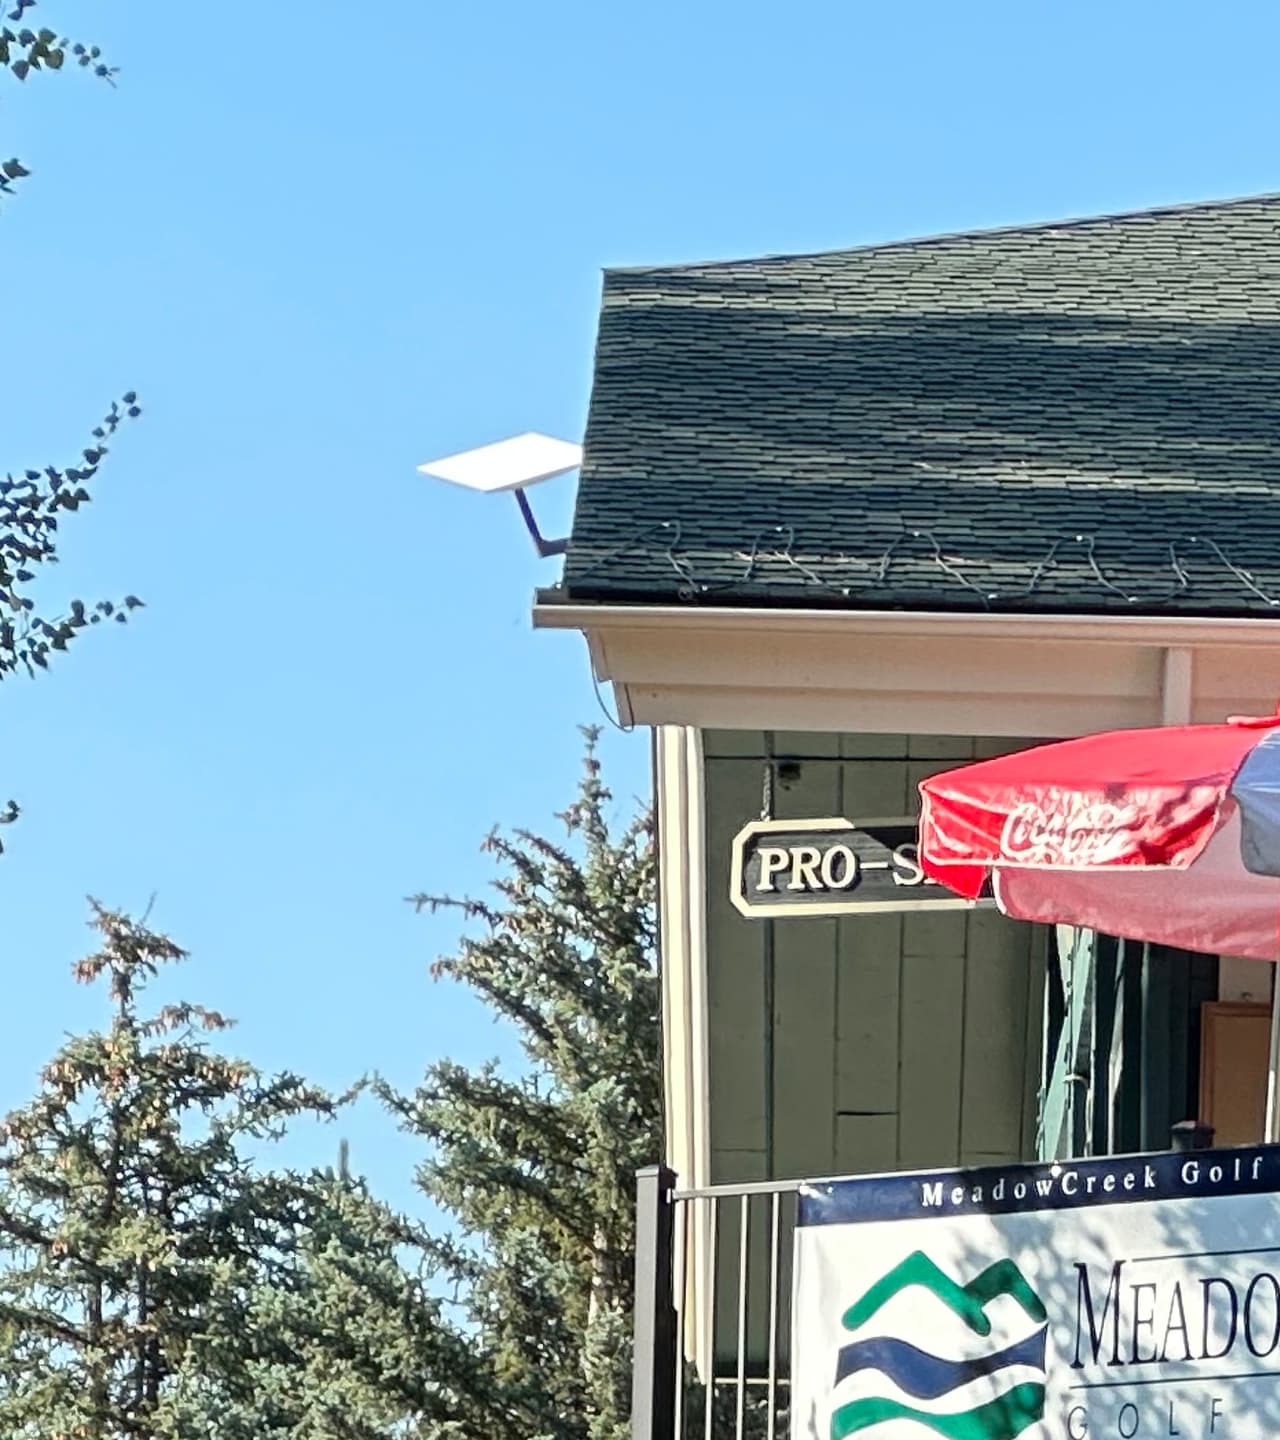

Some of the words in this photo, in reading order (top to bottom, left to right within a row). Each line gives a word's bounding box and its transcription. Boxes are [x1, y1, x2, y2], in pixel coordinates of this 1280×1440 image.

[756, 843, 938, 891] PRO-S
[921, 1164, 1157, 1207] MeadowCreek
[1181, 1156, 1263, 1185] Golf
